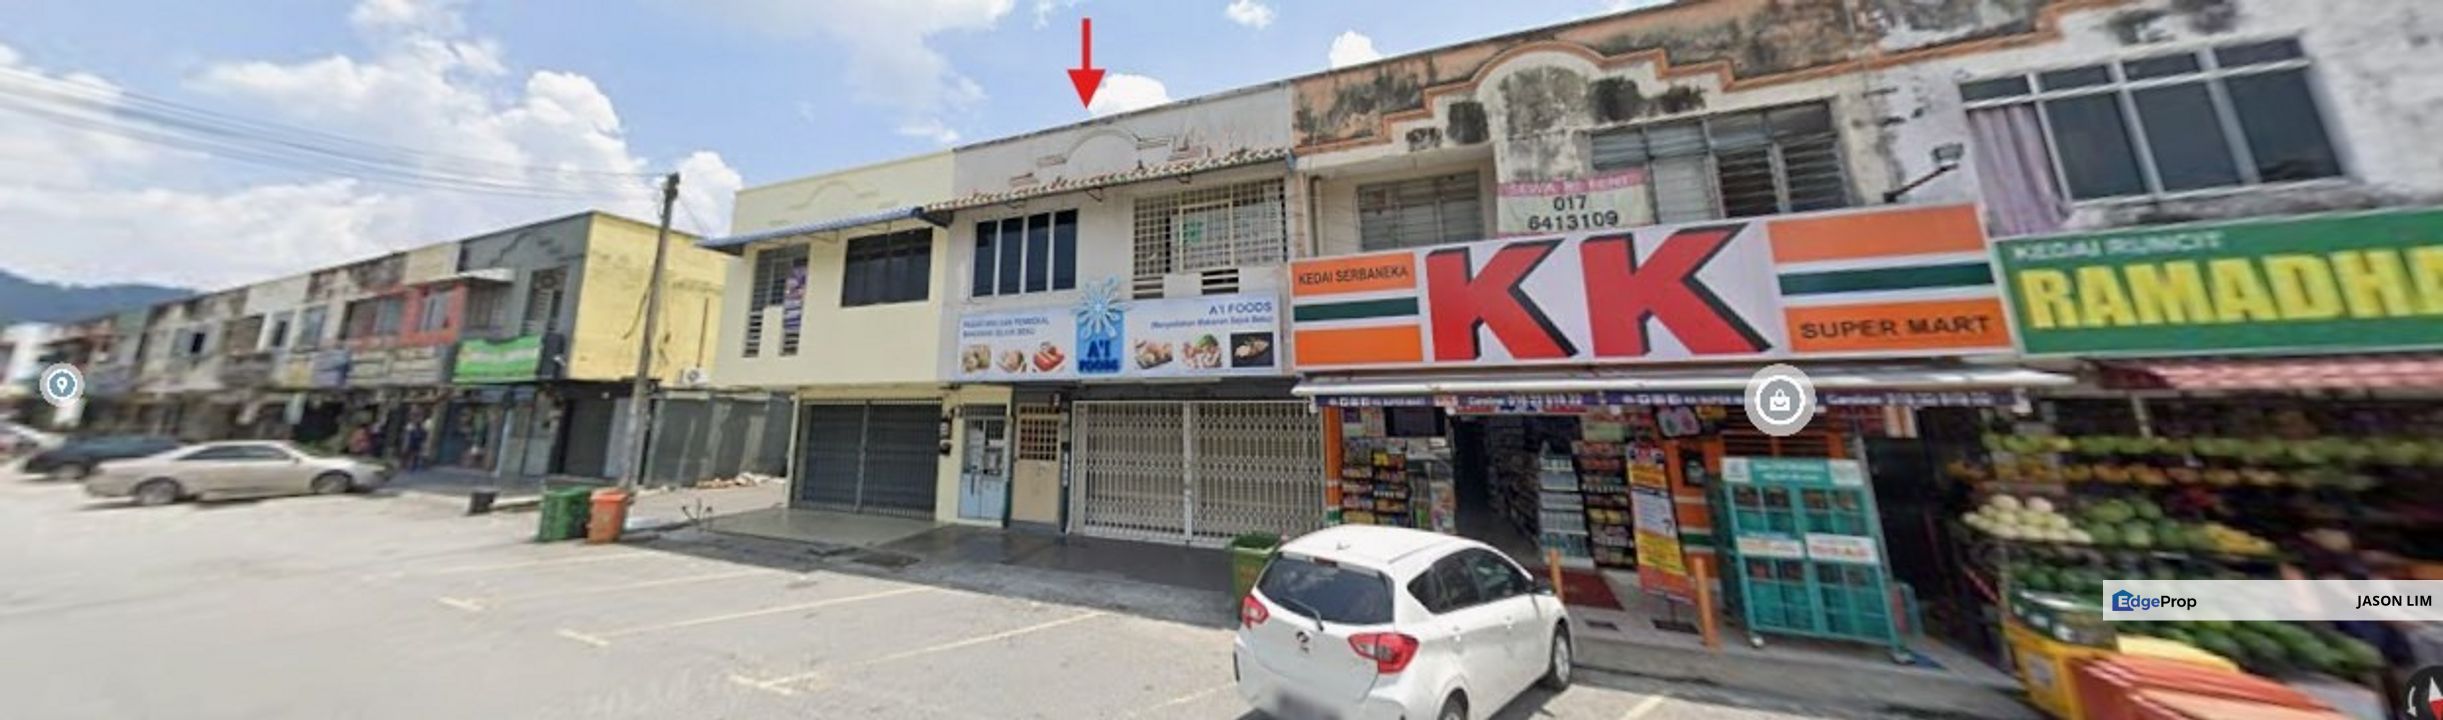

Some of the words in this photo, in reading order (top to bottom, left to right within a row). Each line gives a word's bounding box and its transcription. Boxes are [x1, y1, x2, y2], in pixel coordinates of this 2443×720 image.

[1553, 195, 1587, 212] 017
[1528, 210, 1619, 231] 6413109
[2013, 239, 2102, 260] KEDAI
[2105, 231, 2225, 254] RUNCIT
[1299, 271, 1333, 285] KEDAI
[1335, 265, 1409, 283] SERBANEKA
[1426, 223, 1773, 361] KK
[1228, 301, 1273, 314] FOODS
[1800, 318, 1900, 340] SUPER
[1907, 314, 1990, 335] MART
